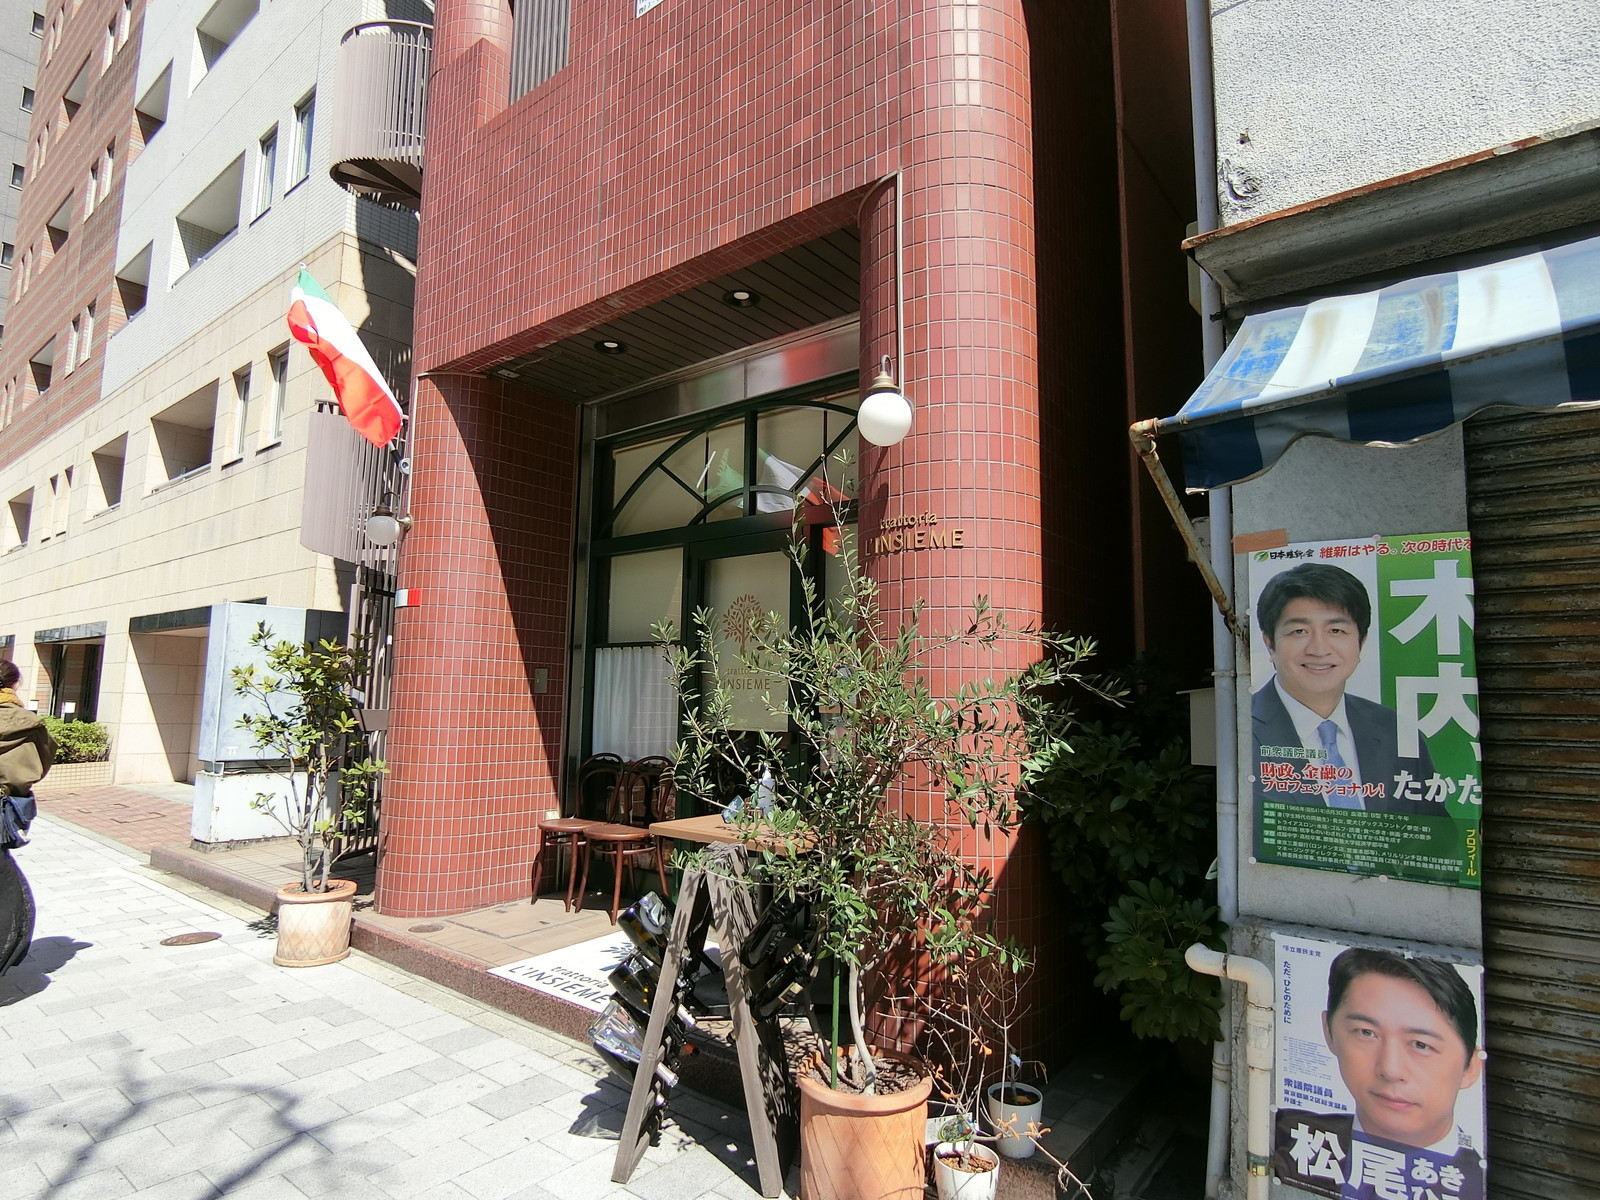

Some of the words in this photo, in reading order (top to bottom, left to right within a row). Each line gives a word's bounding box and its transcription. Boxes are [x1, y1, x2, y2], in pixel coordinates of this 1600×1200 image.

[880, 509, 938, 530] trattoria
[865, 528, 964, 556] L'INSIEME
[1261, 746, 1328, 760] 前衆議院議員
[1261, 762, 1354, 781] 財政、金融の
[1262, 779, 1386, 798] プロフェッショナル!
[1393, 769, 1483, 805] たかた
[1465, 829, 1477, 876] プロフィール
[508, 965, 612, 1005] L'INSIEME
[550, 966, 610, 989] trattoria
[1283, 960, 1292, 1024] ただ、ひとのために
[1284, 1077, 1334, 1099] 衆議院議員
[1289, 1122, 1408, 1200] 松尾
[1411, 1157, 1466, 1193] あき
